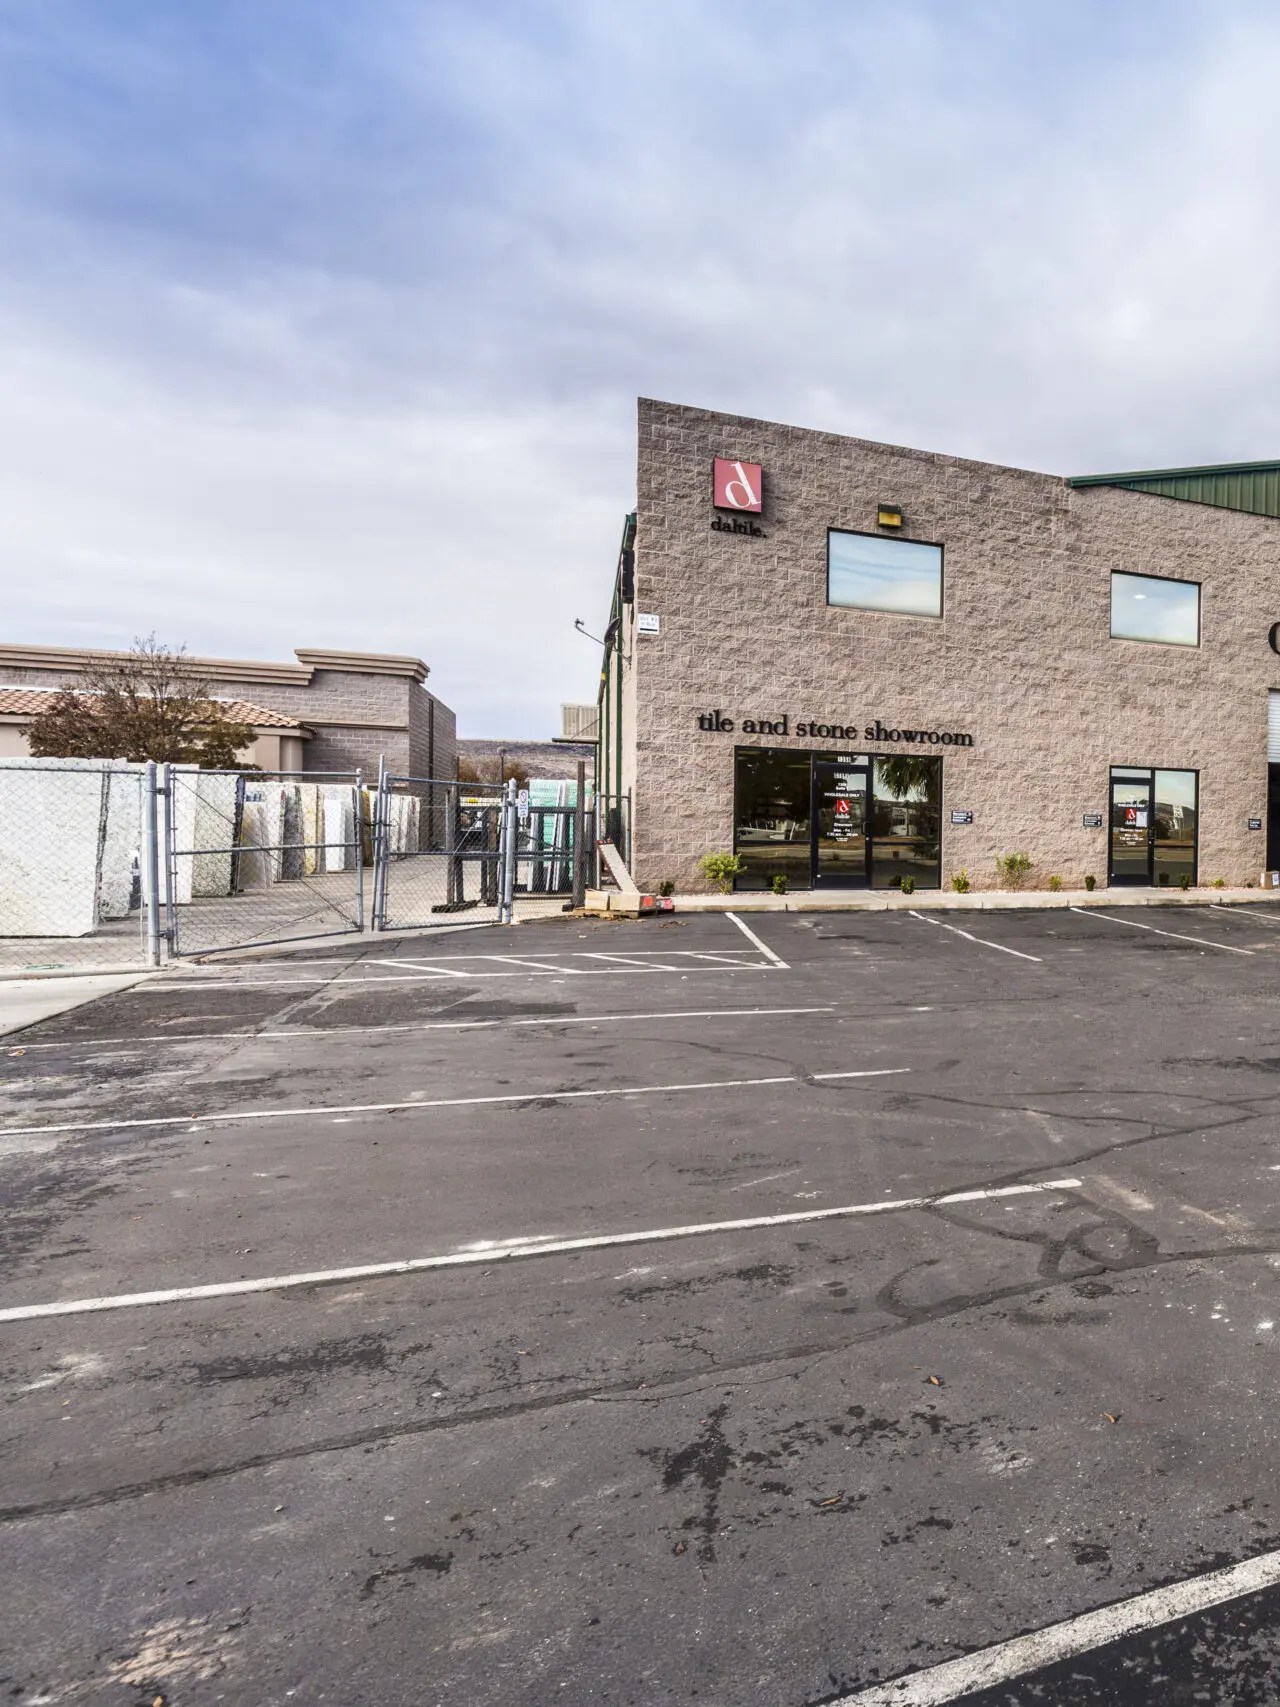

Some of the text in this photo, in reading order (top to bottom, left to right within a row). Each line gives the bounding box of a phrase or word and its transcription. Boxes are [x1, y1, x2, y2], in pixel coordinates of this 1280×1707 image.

[725, 461, 761, 508] d
[697, 709, 974, 747] tile and stone showroom
